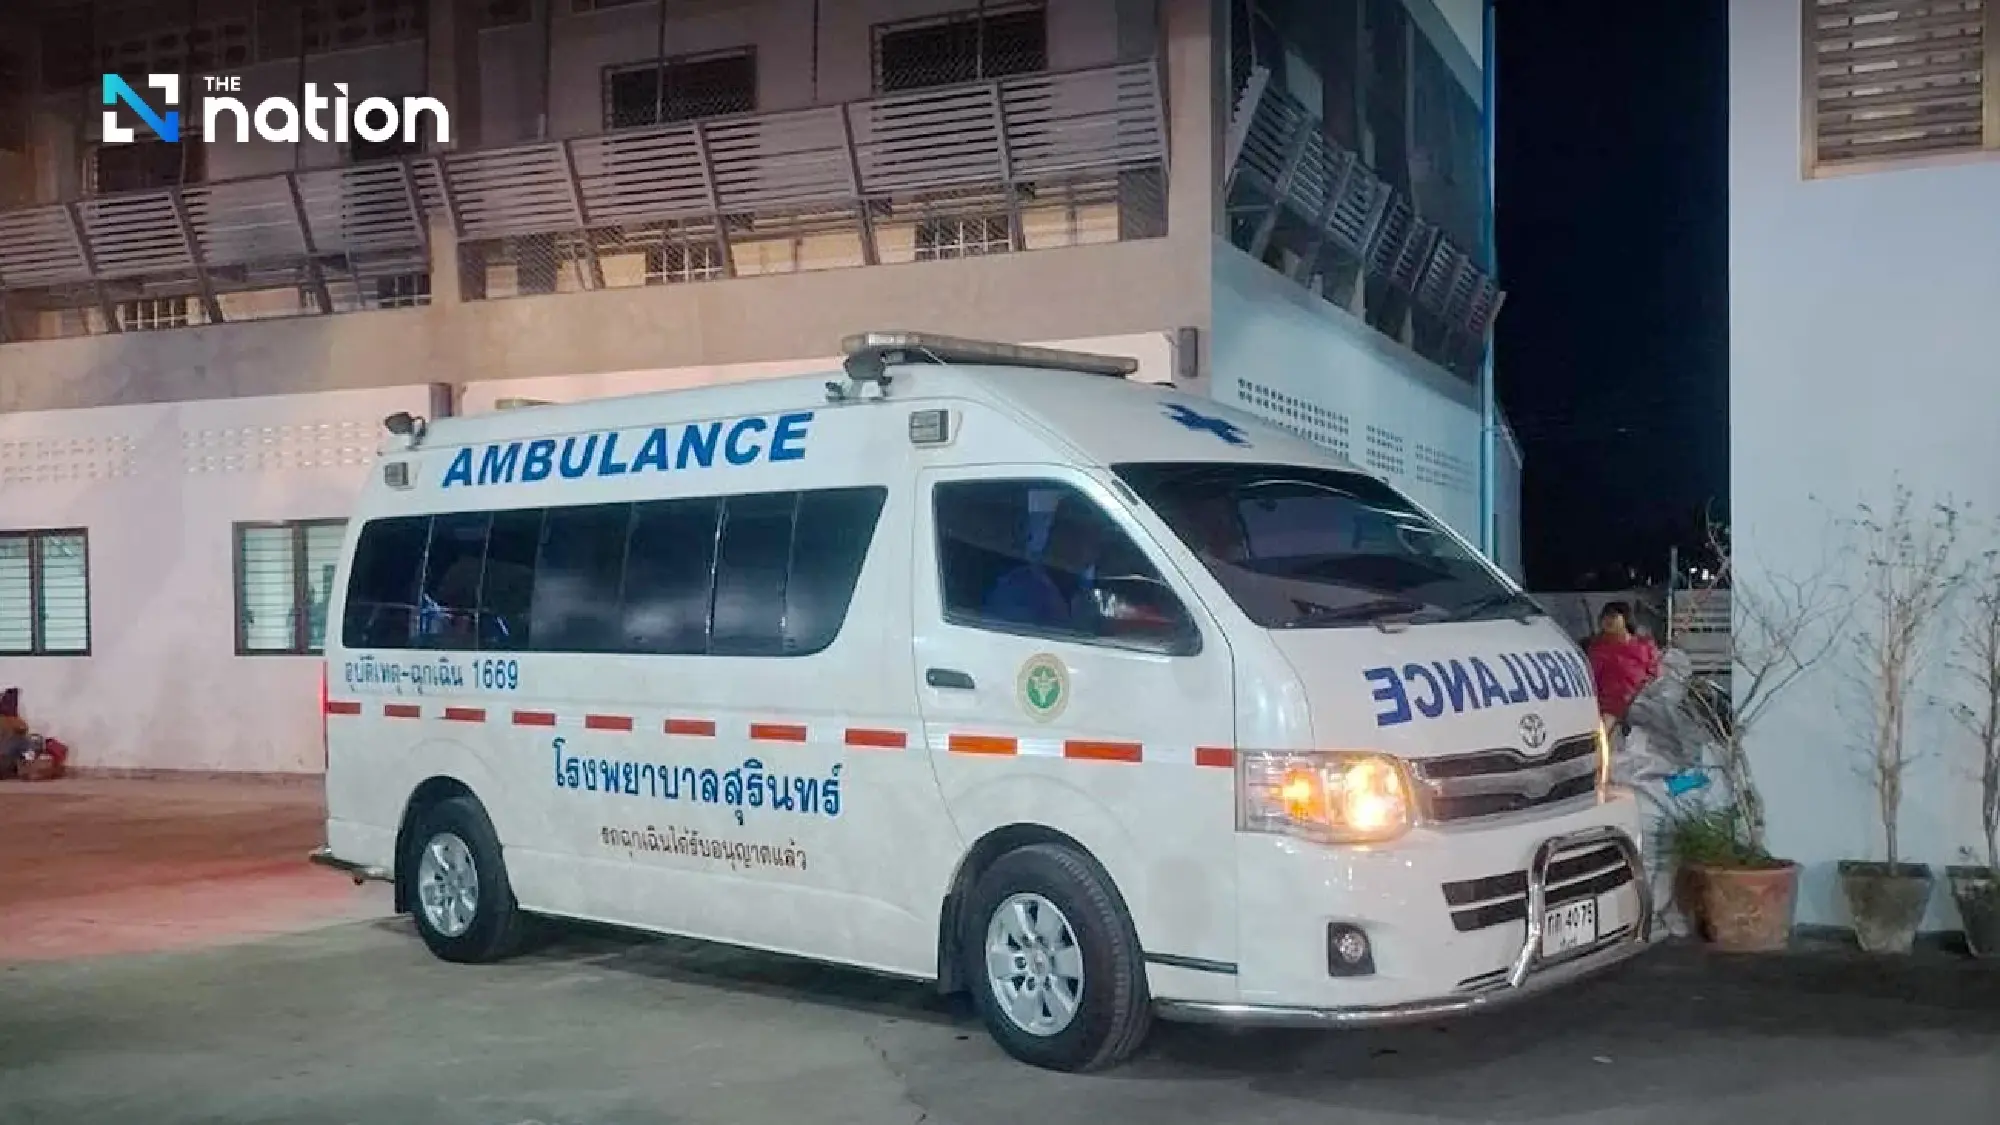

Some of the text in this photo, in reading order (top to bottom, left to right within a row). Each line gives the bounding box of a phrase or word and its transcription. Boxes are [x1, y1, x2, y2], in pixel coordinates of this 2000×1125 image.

[442, 412, 814, 488] AMBULANCE
[472, 659, 518, 689] 1669
[552, 737, 842, 825] โรงพยาบาลสุรินทร์
